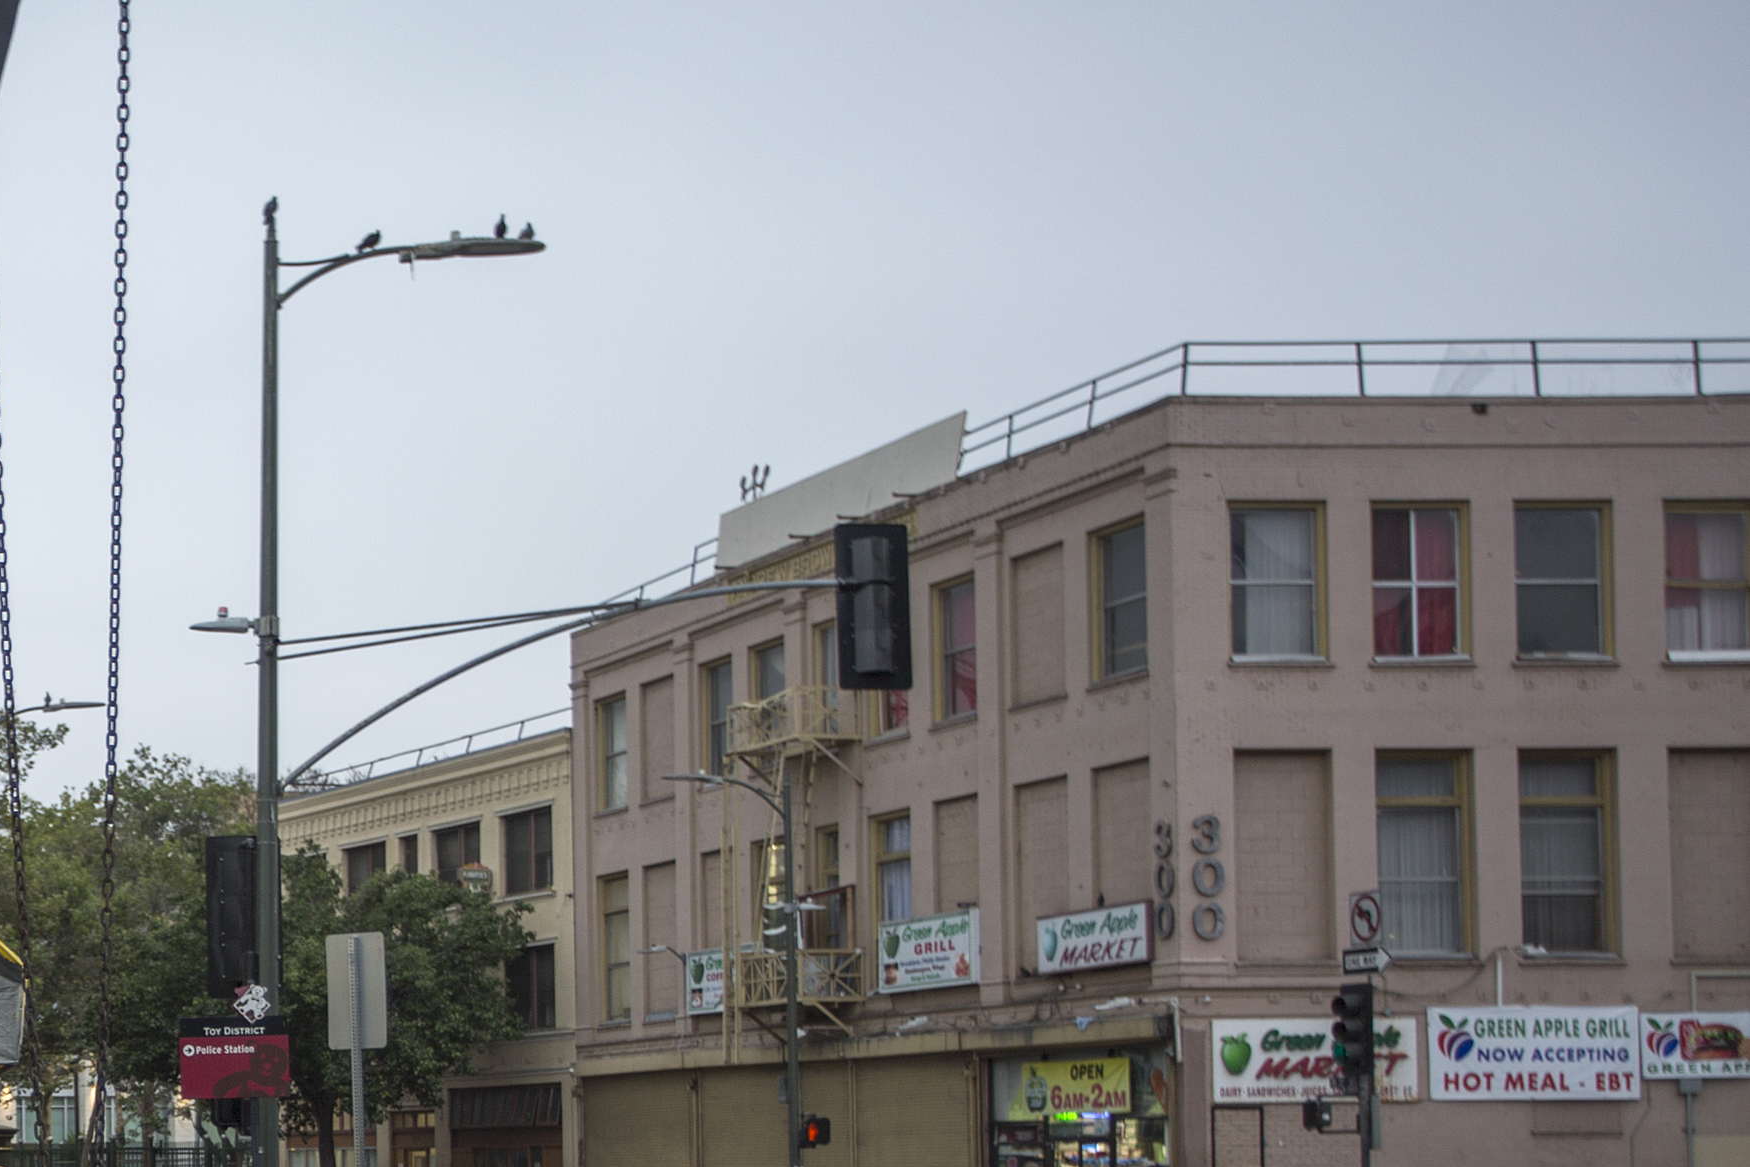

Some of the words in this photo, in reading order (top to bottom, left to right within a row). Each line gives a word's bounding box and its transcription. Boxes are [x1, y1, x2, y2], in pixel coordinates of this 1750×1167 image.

[1192, 814, 1225, 941] 300
[1061, 917, 1096, 940] Green
[1099, 907, 1138, 936] Apple
[902, 925, 932, 942] Green
[914, 939, 955, 955] GRILL
[1059, 936, 1143, 967] MARKET
[1474, 1018, 1526, 1039] GREEN
[1532, 1018, 1580, 1038] APPLE
[1585, 1018, 1630, 1039] GRILL
[195, 1045, 221, 1055] Police
[224, 1044, 255, 1055] Station
[1261, 1029, 1326, 1052] Green
[1476, 1048, 1524, 1062] NOW
[1531, 1047, 1630, 1063] ACCEPTING
[1070, 1063, 1104, 1080] OPEN
[1647, 1062, 1712, 1074] GREEN
[1443, 1073, 1495, 1092] HOT
[1504, 1073, 1570, 1092] MEAL
[1595, 1073, 1634, 1092] EBT
